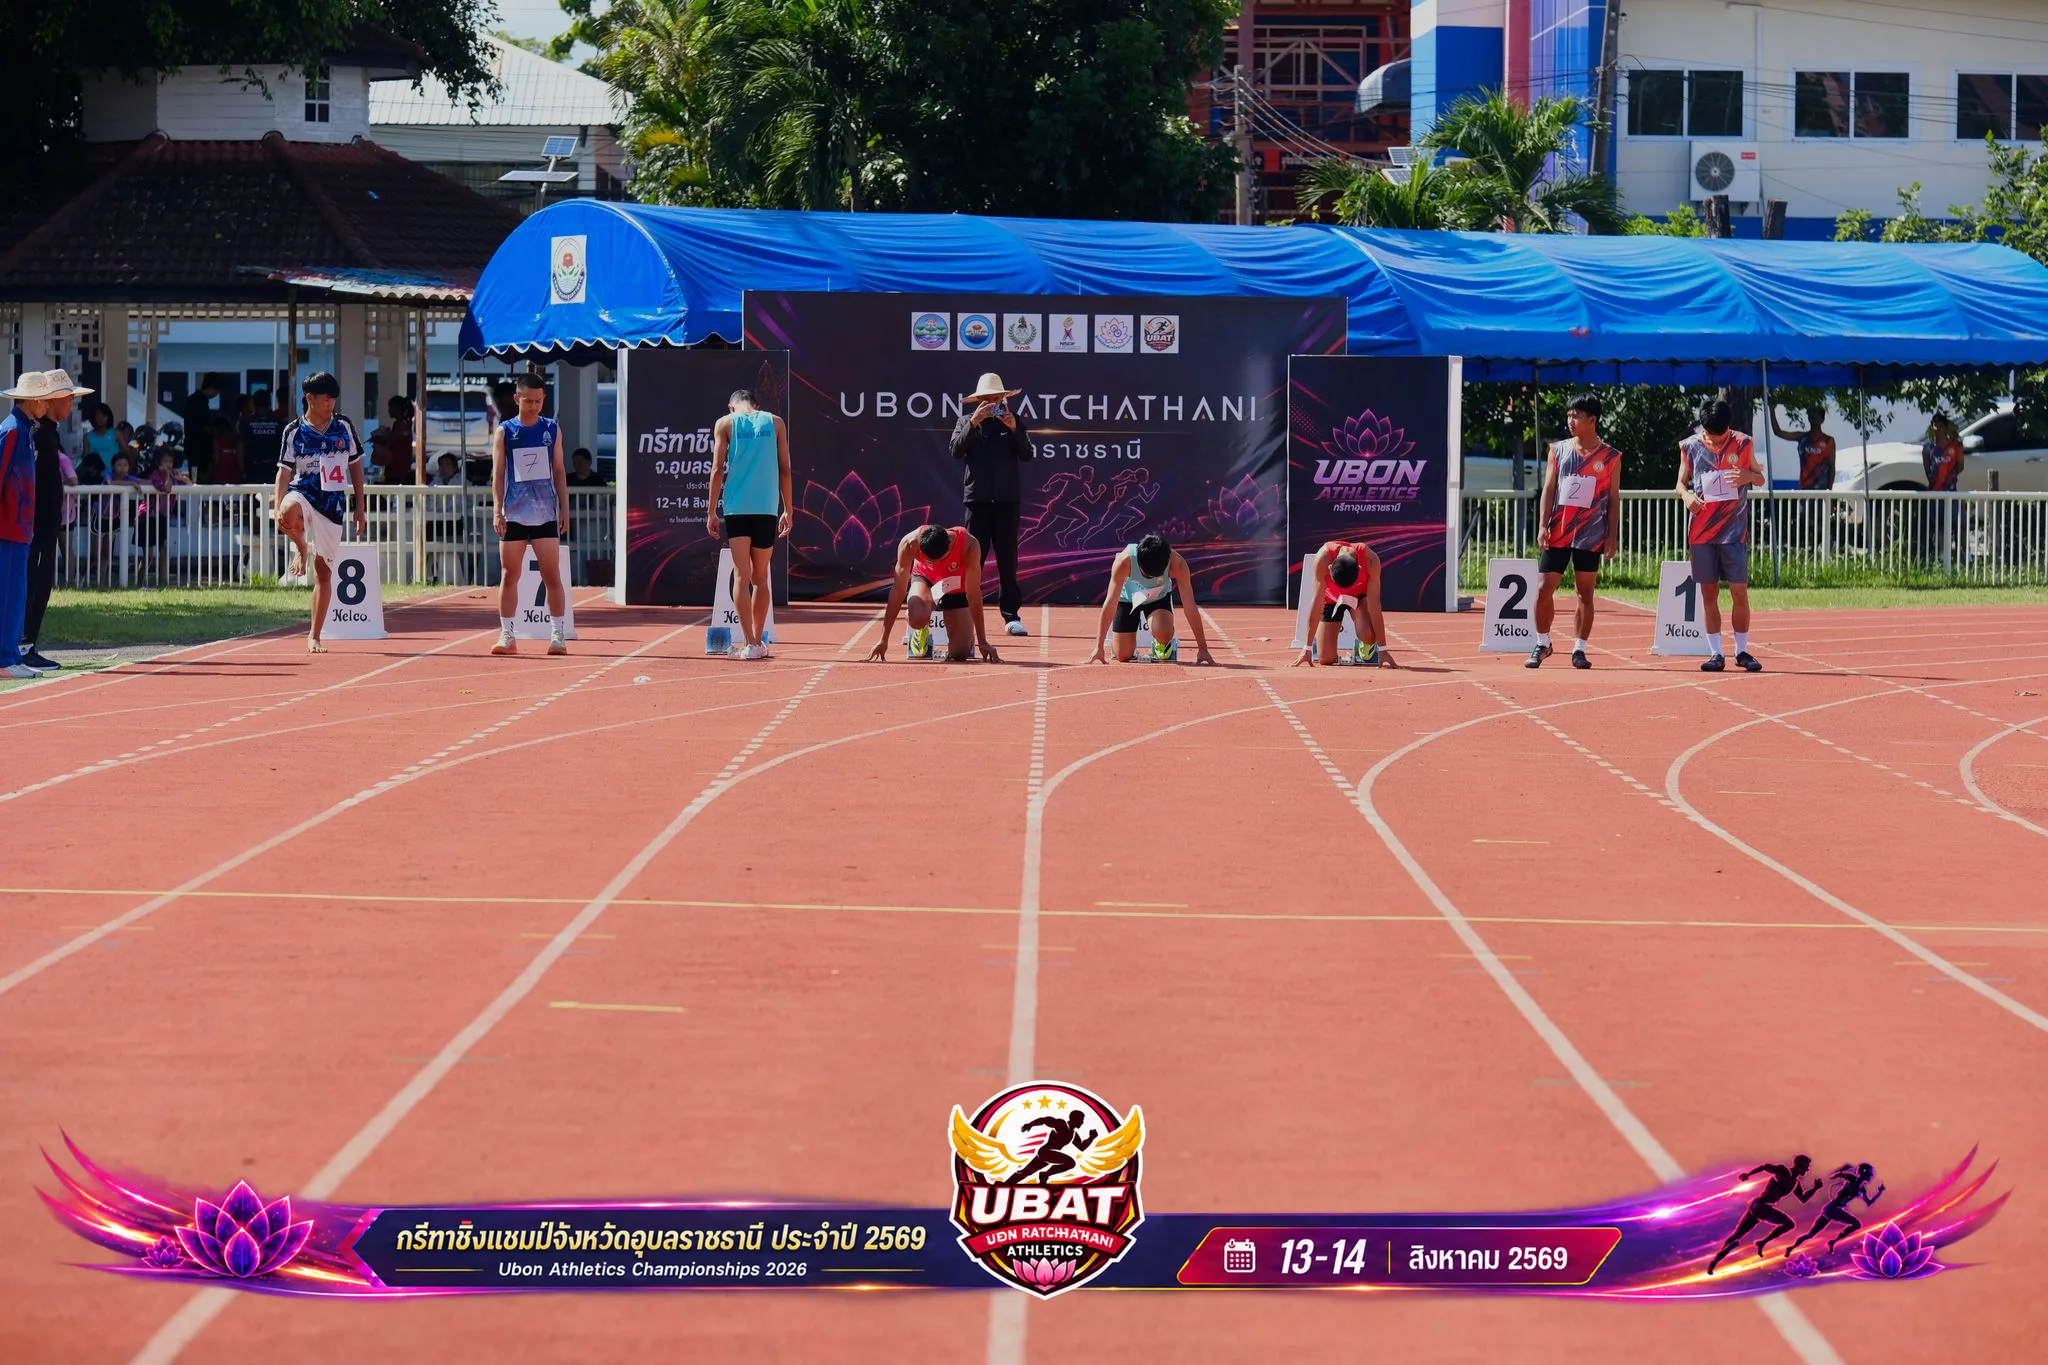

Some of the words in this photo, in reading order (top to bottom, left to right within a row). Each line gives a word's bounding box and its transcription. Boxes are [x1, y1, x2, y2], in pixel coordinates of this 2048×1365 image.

[840, 391, 964, 418] UBON
[523, 453, 538, 473] 7
[1313, 459, 1428, 485] UBON
[320, 465, 345, 484] 14
[1313, 486, 1420, 500] ATHLETICS
[1567, 482, 1582, 500] 2
[1712, 474, 1730, 497] 1
[336, 558, 367, 606] 8
[1498, 574, 1528, 619] 2
[1675, 575, 1697, 622] 1
[332, 608, 368, 622] Nelco
[1494, 623, 1529, 637] Nelco
[1665, 623, 1700, 638] Nelco
